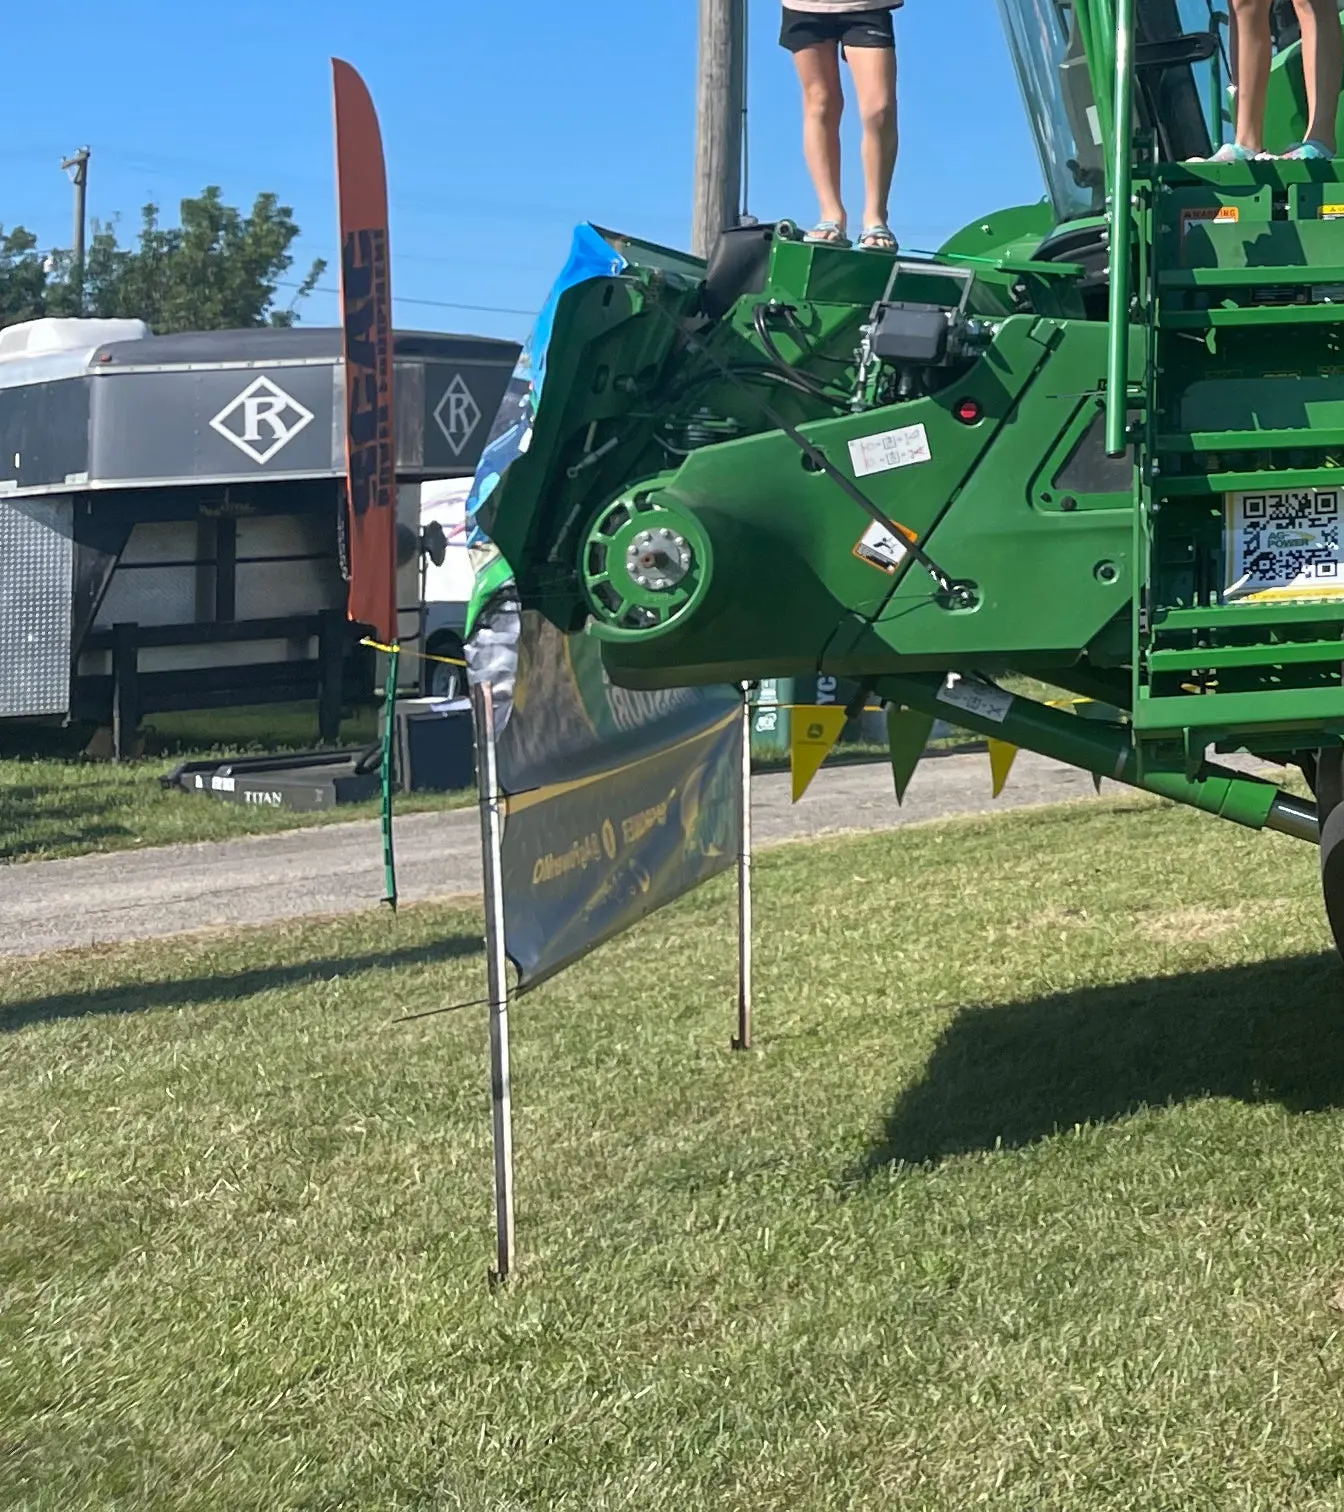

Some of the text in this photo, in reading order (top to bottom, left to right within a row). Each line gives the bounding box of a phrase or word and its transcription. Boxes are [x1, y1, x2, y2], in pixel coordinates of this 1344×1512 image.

[242, 395, 289, 441] R
[449, 393, 470, 434] R
[244, 791, 282, 807] TITAN
